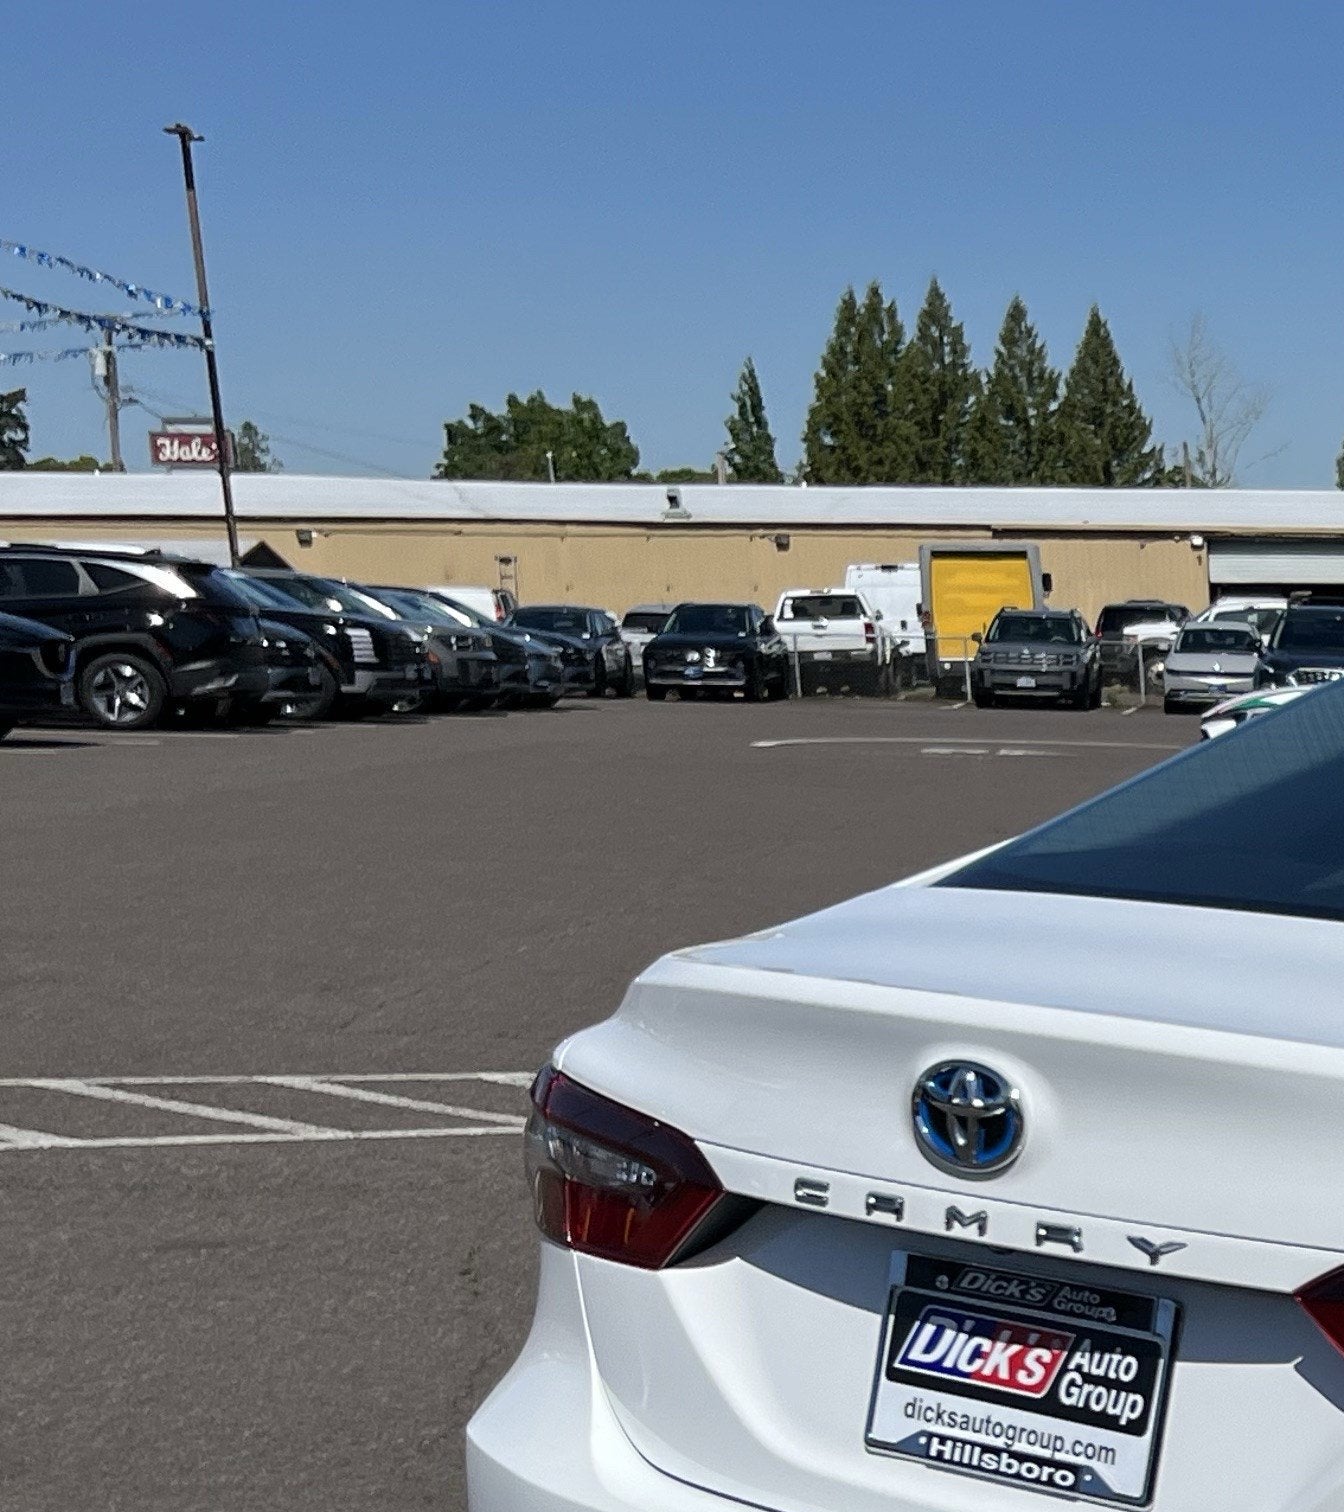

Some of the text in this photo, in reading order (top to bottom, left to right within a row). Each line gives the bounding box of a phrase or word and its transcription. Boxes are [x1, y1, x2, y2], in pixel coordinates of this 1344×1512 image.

[156, 437, 219, 462] Hale'
[793, 1171, 1189, 1266] CAMRY
[1053, 1298, 1112, 1321] Group
[1057, 1286, 1100, 1305] Auto
[1067, 1339, 1139, 1383] Auto
[1058, 1374, 1146, 1426] Group
[903, 1397, 1117, 1466] dicksautogroup.com
[928, 1436, 1077, 1488] Hillsboro
